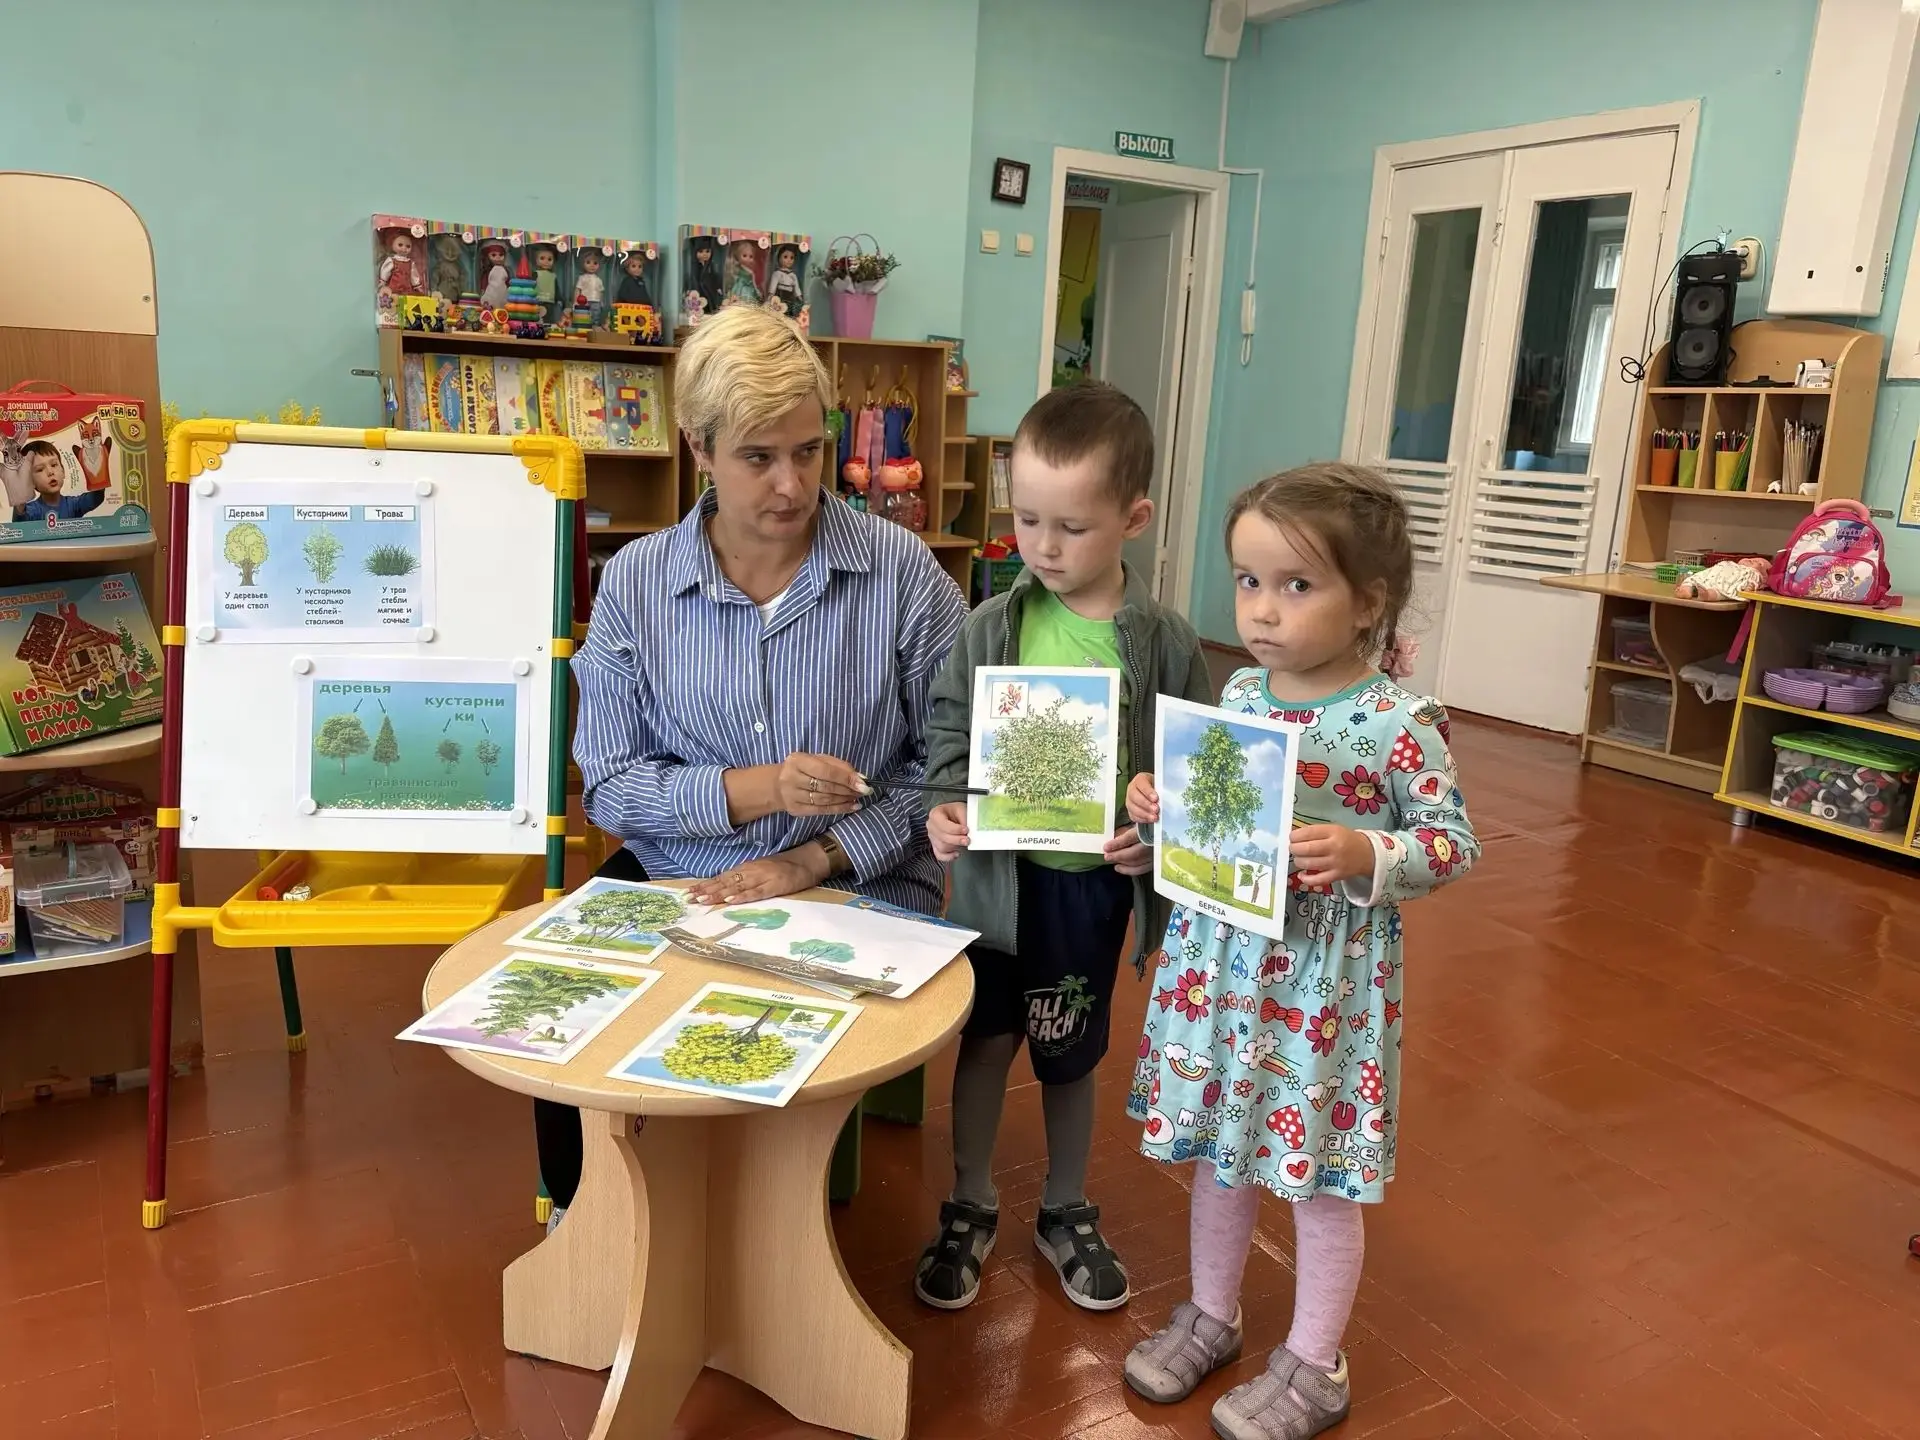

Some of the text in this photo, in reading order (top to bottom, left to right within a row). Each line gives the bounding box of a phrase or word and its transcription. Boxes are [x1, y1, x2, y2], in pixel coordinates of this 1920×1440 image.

[1119, 133, 1170, 157] ВЫХОД
[465, 365, 475, 393] УЗОР
[7, 402, 48, 410] ДОМАШНИЙ
[100, 406, 137, 418] БИ БА БО
[228, 509, 265, 519] Деревья
[296, 509, 348, 519] Кустарники
[376, 509, 404, 518] Травы
[47, 514, 57, 528] 8
[296, 587, 351, 596] У кустарников
[382, 586, 388, 594] У
[225, 591, 268, 601] У деревьев
[381, 596, 408, 604] стебли
[225, 602, 269, 610] один ствол
[306, 607, 342, 616] стеблей-
[304, 617, 344, 625] стволиков
[383, 617, 410, 625] сочные
[319, 682, 391, 695] деревья
[12, 686, 55, 706] КОТ,
[425, 696, 505, 708] кустарни
[19, 700, 79, 725] ПЕТУХ
[455, 712, 474, 722] ки
[26, 727, 42, 745] И
[43, 716, 93, 740] ЛИСА
[1016, 837, 1061, 846] БАРБАРИС
[1028, 995, 1062, 1019] ALI
[1029, 1009, 1077, 1041] EACH
[1177, 1106, 1223, 1128] mak
[1172, 1138, 1217, 1161] Smil
